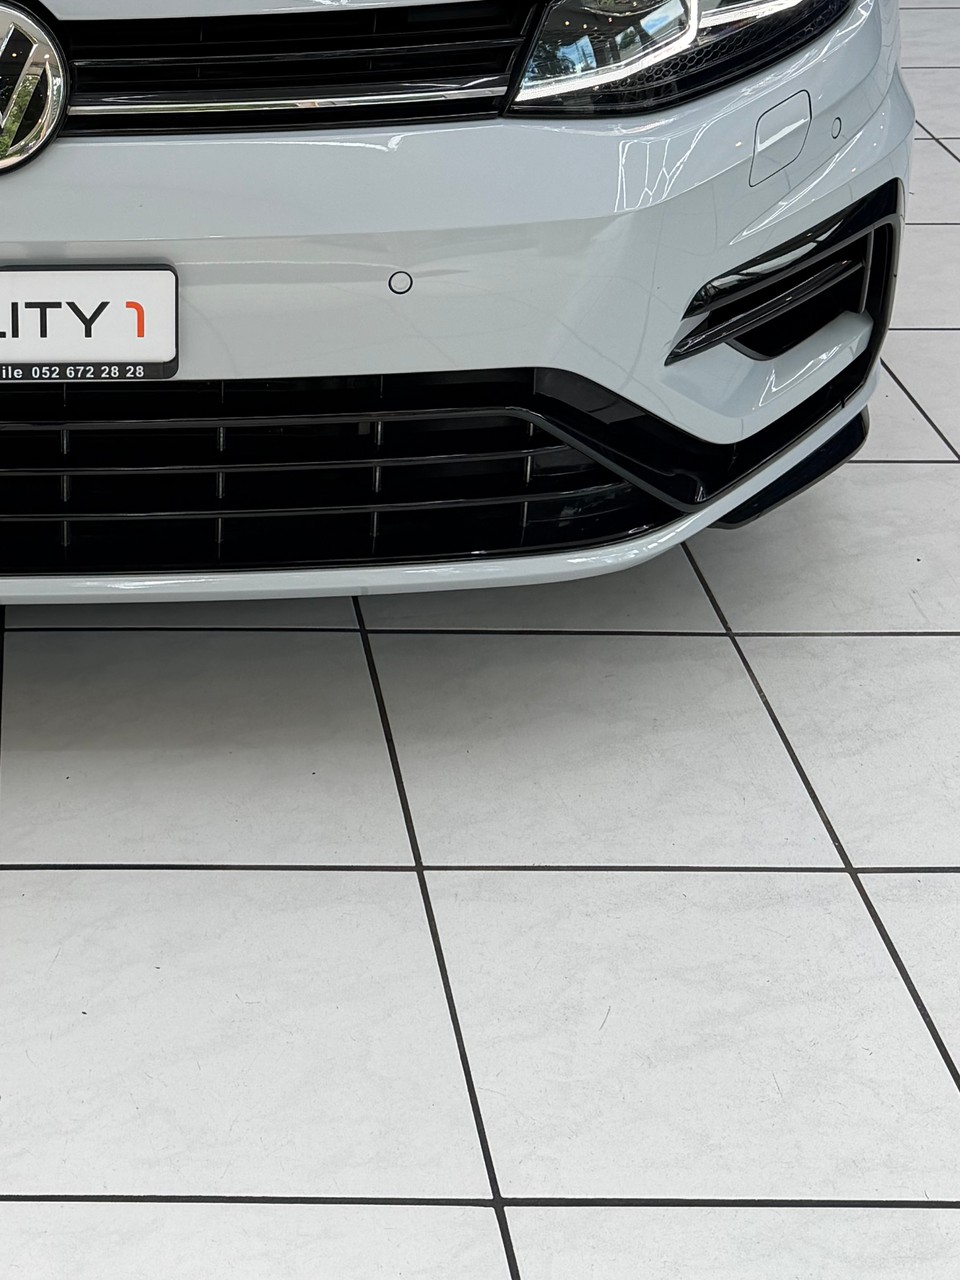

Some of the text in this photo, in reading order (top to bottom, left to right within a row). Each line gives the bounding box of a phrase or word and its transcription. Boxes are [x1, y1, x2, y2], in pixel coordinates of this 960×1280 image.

[125, 301, 145, 338] 1
[31, 367, 60, 379] 052
[66, 366, 94, 379] 672
[100, 366, 120, 378] 28
[125, 366, 144, 377] 28
